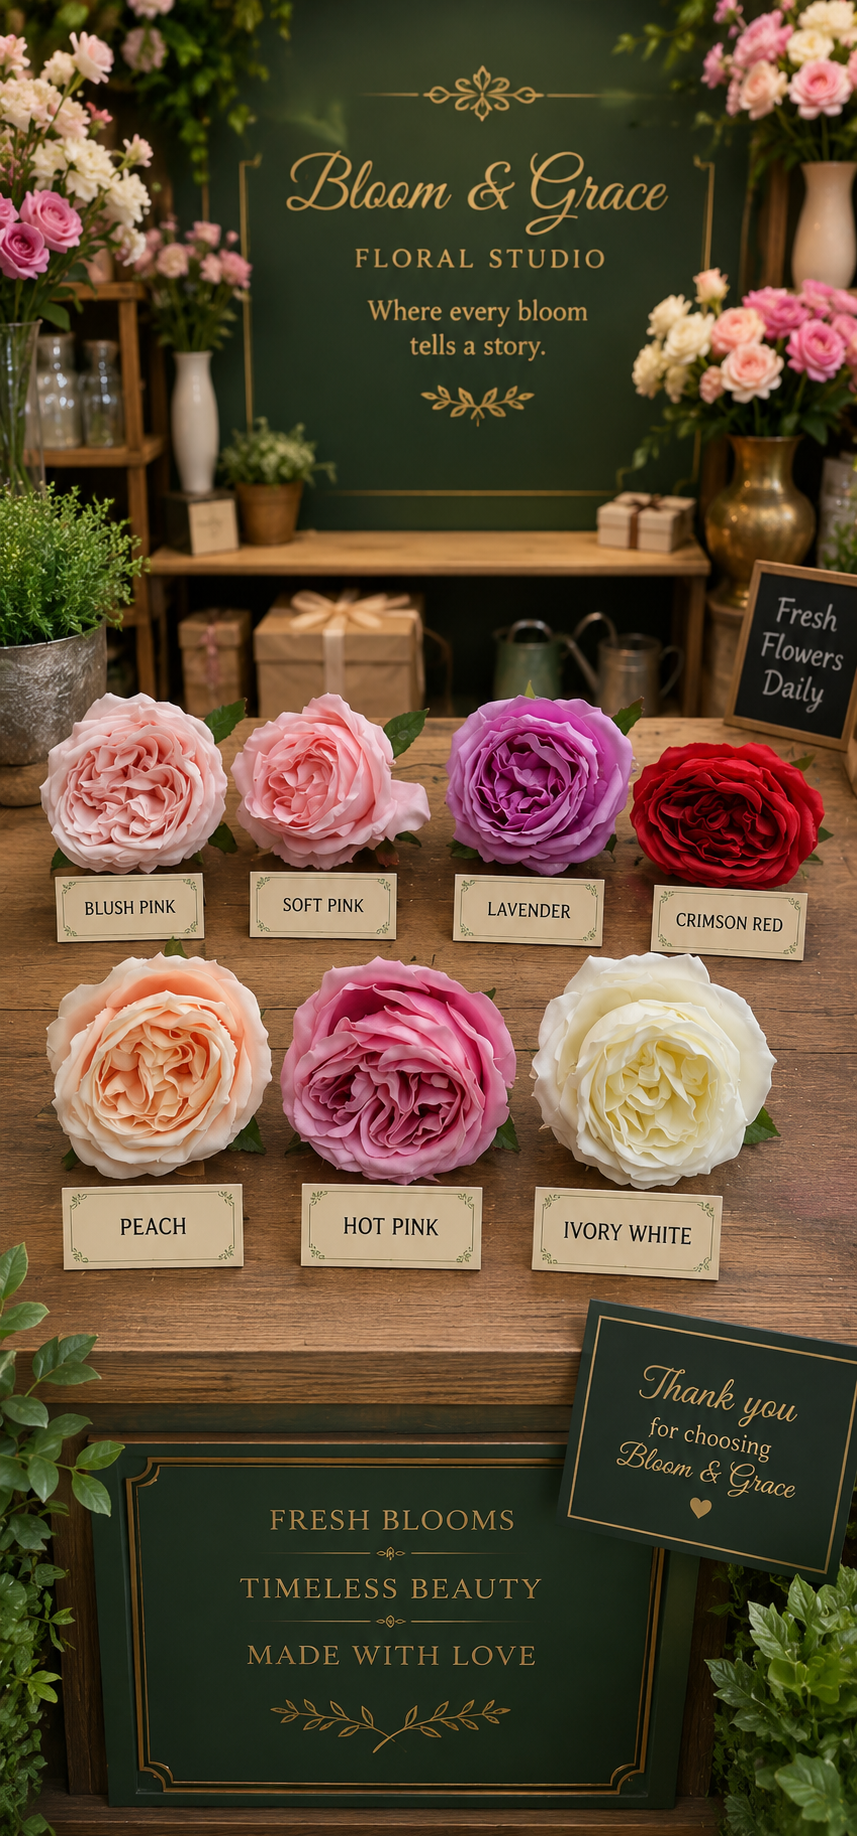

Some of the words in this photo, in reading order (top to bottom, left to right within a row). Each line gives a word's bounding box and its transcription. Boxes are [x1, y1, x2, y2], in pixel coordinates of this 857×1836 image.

[286, 150, 452, 211] Bloom
[467, 160, 516, 211] &
[525, 151, 668, 236] Grace
[355, 248, 474, 269] FLORAL
[489, 248, 605, 269] STUDIO
[367, 298, 443, 321] Where
[449, 306, 511, 328] every
[517, 298, 588, 322] bloom
[409, 333, 456, 356] tells
[463, 340, 476, 356] a
[483, 337, 546, 362] story.
[776, 597, 837, 632] Fresh
[761, 631, 844, 671] Flowers
[762, 669, 824, 713] Daily
[84, 900, 134, 916] BLUSH
[139, 899, 176, 915] PINK
[283, 897, 323, 913] SOFT
[328, 898, 364, 913] PINK
[487, 901, 571, 919] LAVENDER
[676, 912, 748, 931] CRIMSON
[752, 916, 783, 933] RED
[120, 1217, 187, 1236] PEACH
[343, 1216, 386, 1235] HOT
[392, 1217, 439, 1236] PINK
[563, 1221, 623, 1241] IVORY
[628, 1224, 692, 1245] WHITE
[638, 1364, 735, 1411] Thank
[737, 1397, 798, 1428] you
[648, 1416, 679, 1439] for
[684, 1424, 772, 1463] choosing
[616, 1440, 693, 1478] Bloom
[699, 1460, 722, 1484] &
[727, 1461, 796, 1499] Grace
[270, 1509, 370, 1531] FRESH
[382, 1509, 514, 1531] BLOOMS
[239, 1577, 397, 1599] TIMELESS
[411, 1578, 542, 1599] BEAUTY
[247, 1645, 340, 1665] MADE
[351, 1645, 439, 1666] WITH
[452, 1645, 536, 1666] LOVE
